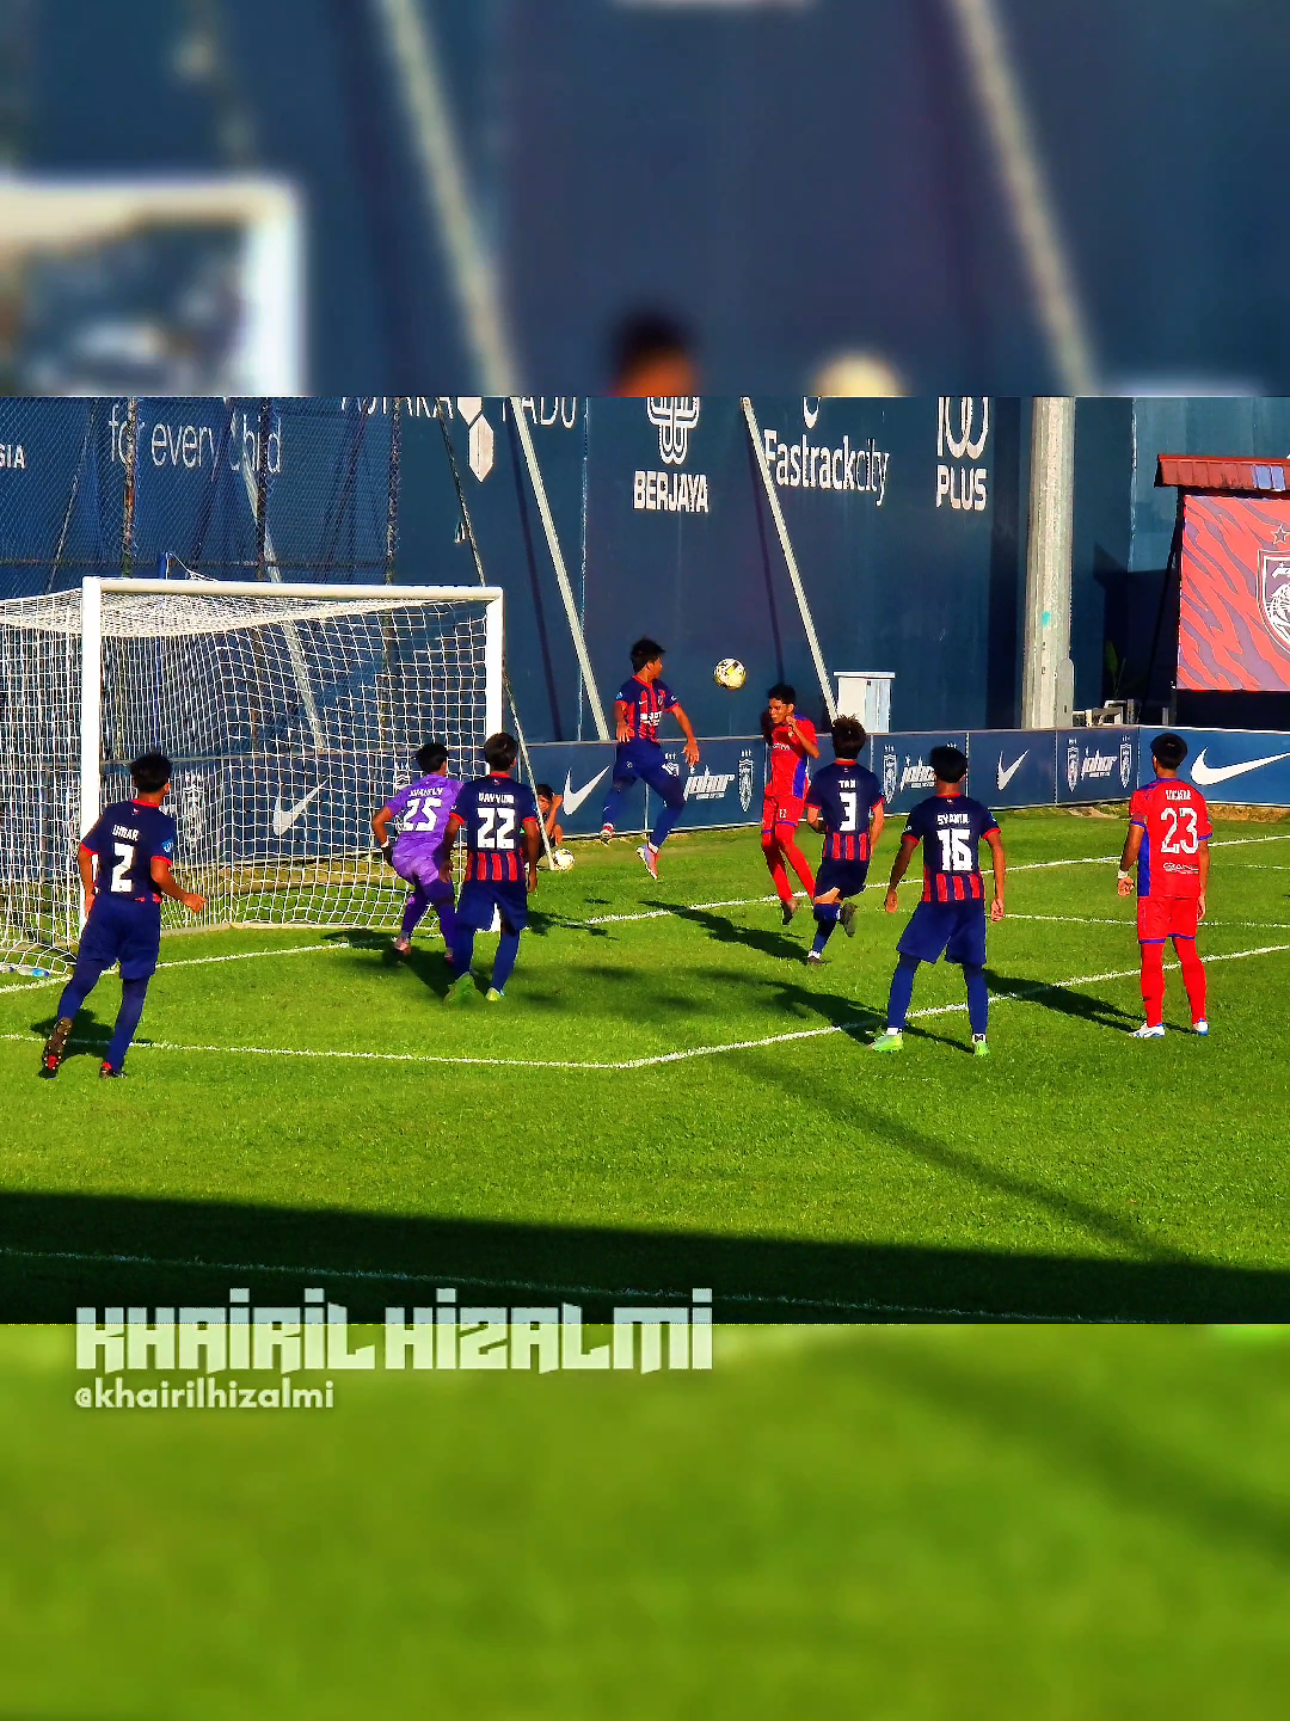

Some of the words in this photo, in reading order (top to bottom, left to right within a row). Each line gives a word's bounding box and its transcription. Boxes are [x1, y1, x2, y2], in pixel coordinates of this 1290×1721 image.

[229, 414, 282, 473] hid
[764, 429, 890, 507] Fastrackcity
[936, 464, 988, 511] PLUS
[633, 470, 709, 513] BERJAYA
[401, 797, 443, 832] 25
[476, 807, 516, 850] 22
[839, 792, 857, 832] 3
[1160, 807, 1199, 855] 23
[110, 842, 135, 893] 2
[936, 828, 973, 871] 16
